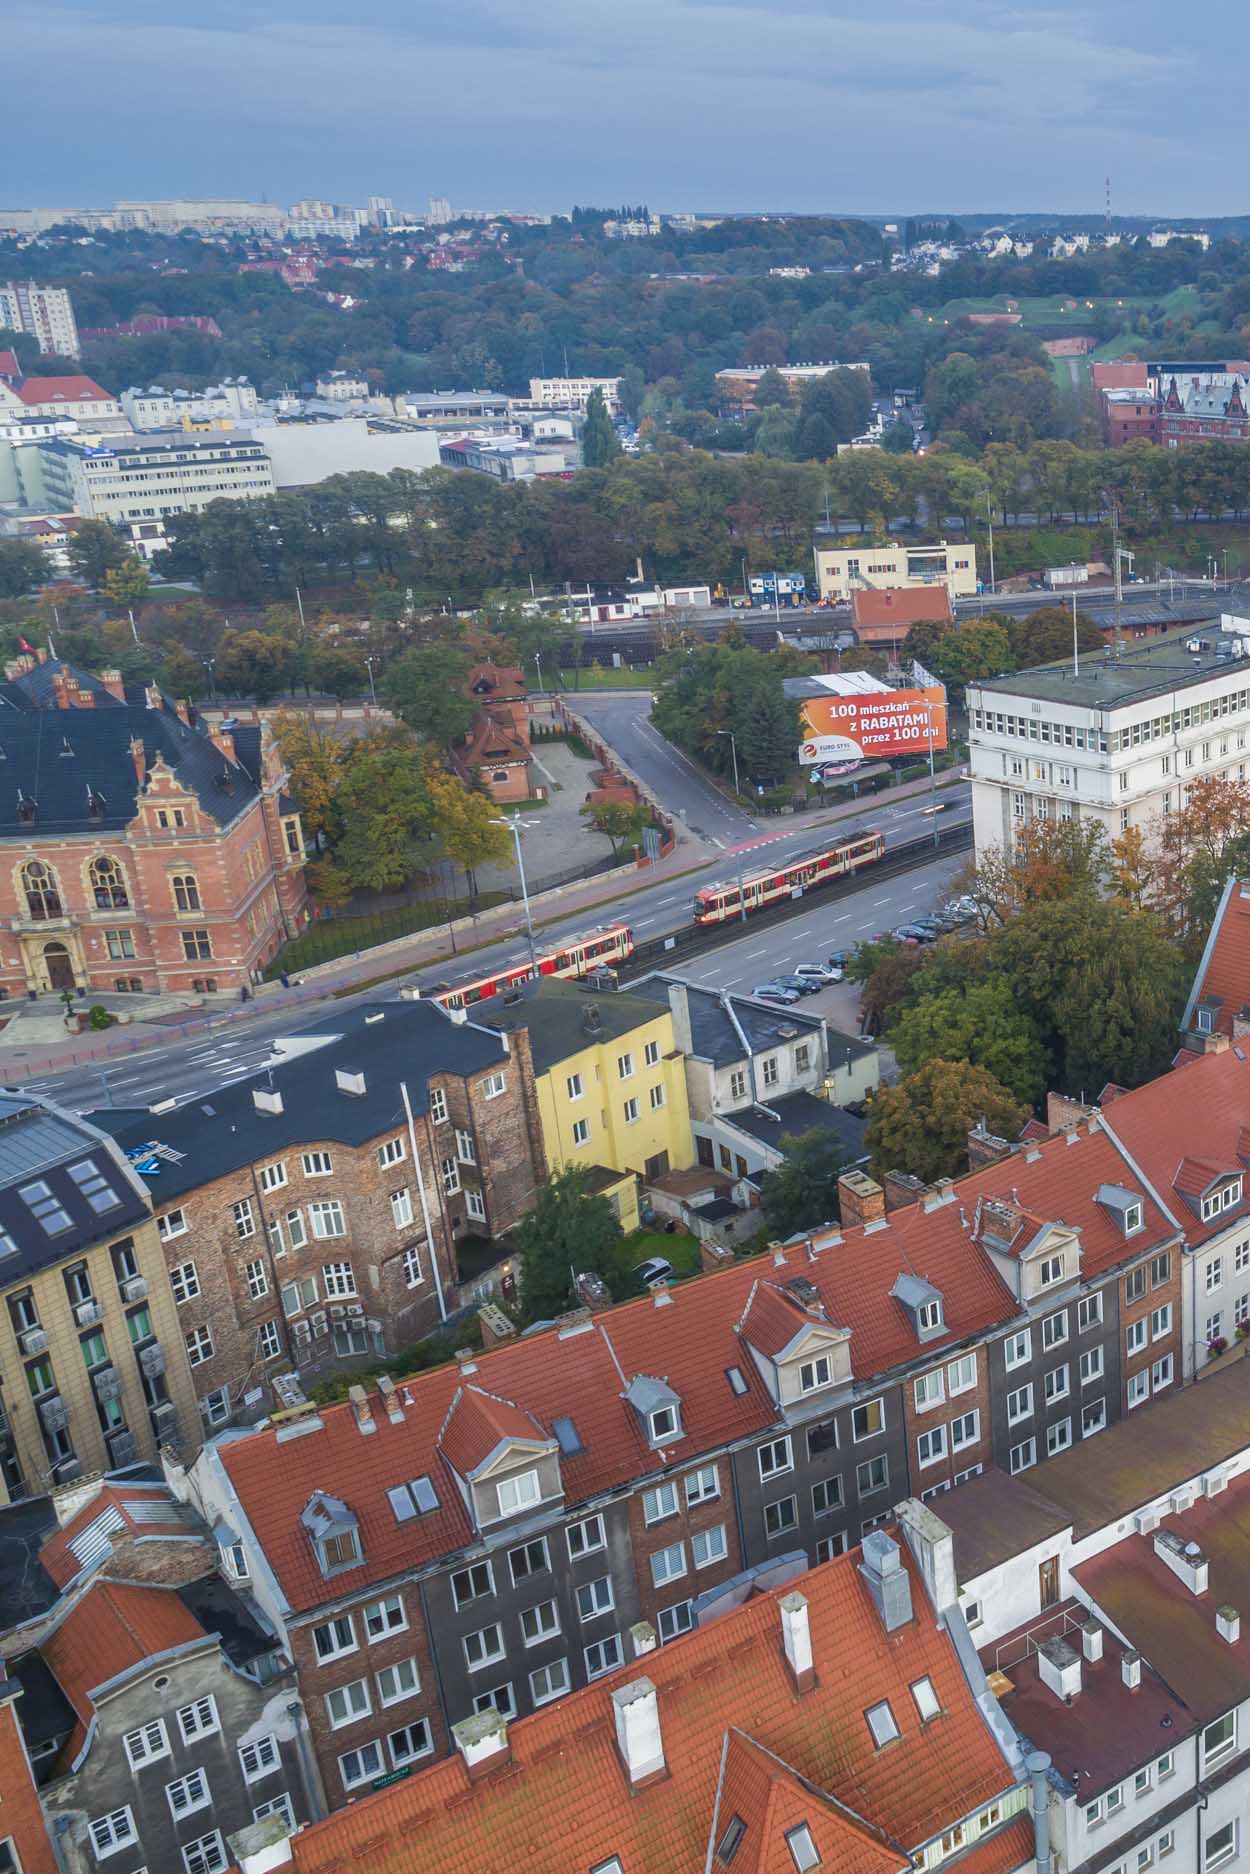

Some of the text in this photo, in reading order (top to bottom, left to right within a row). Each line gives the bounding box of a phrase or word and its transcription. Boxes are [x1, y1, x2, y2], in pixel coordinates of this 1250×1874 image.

[830, 701, 909, 718] 100 mieszkań
[850, 713, 928, 732] z RABATAMI
[862, 727, 939, 745] przez 100 dni
